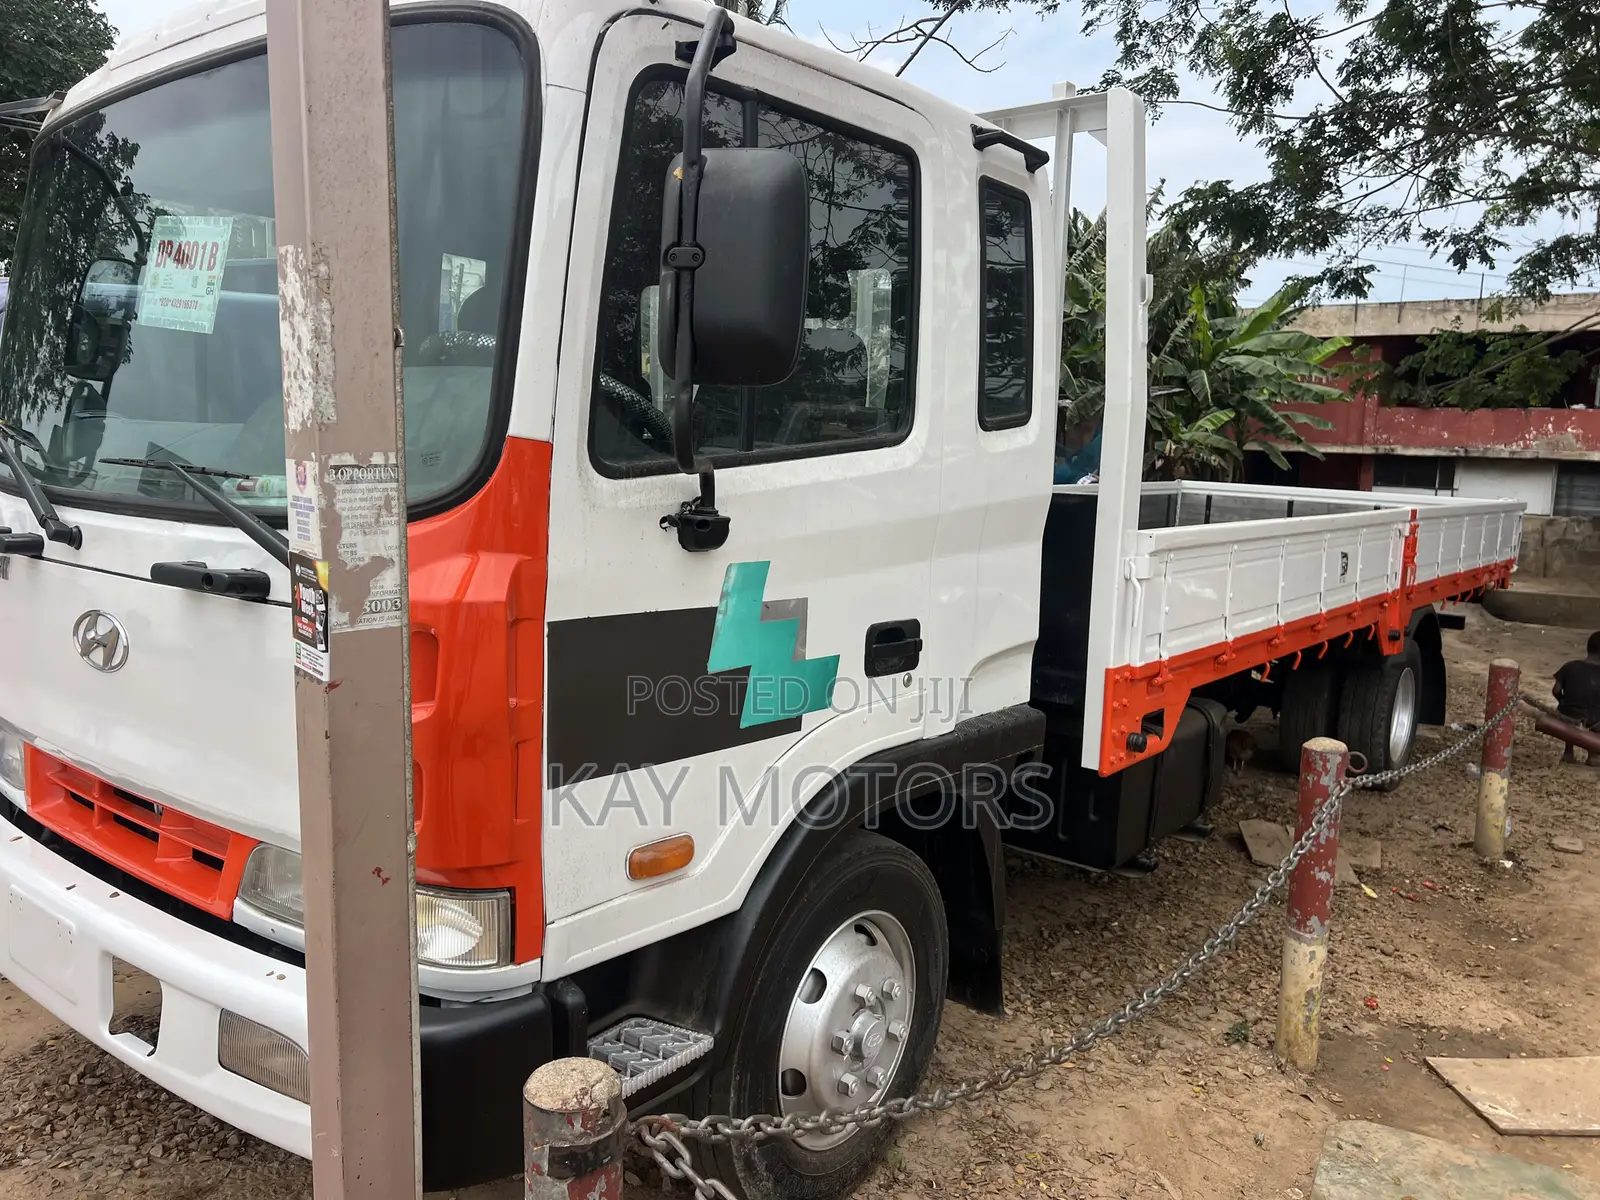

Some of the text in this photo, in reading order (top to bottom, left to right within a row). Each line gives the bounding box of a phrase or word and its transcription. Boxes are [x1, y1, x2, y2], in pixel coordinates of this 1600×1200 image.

[155, 240, 174, 268] DP
[207, 242, 219, 271] B
[206, 286, 215, 296] GH
